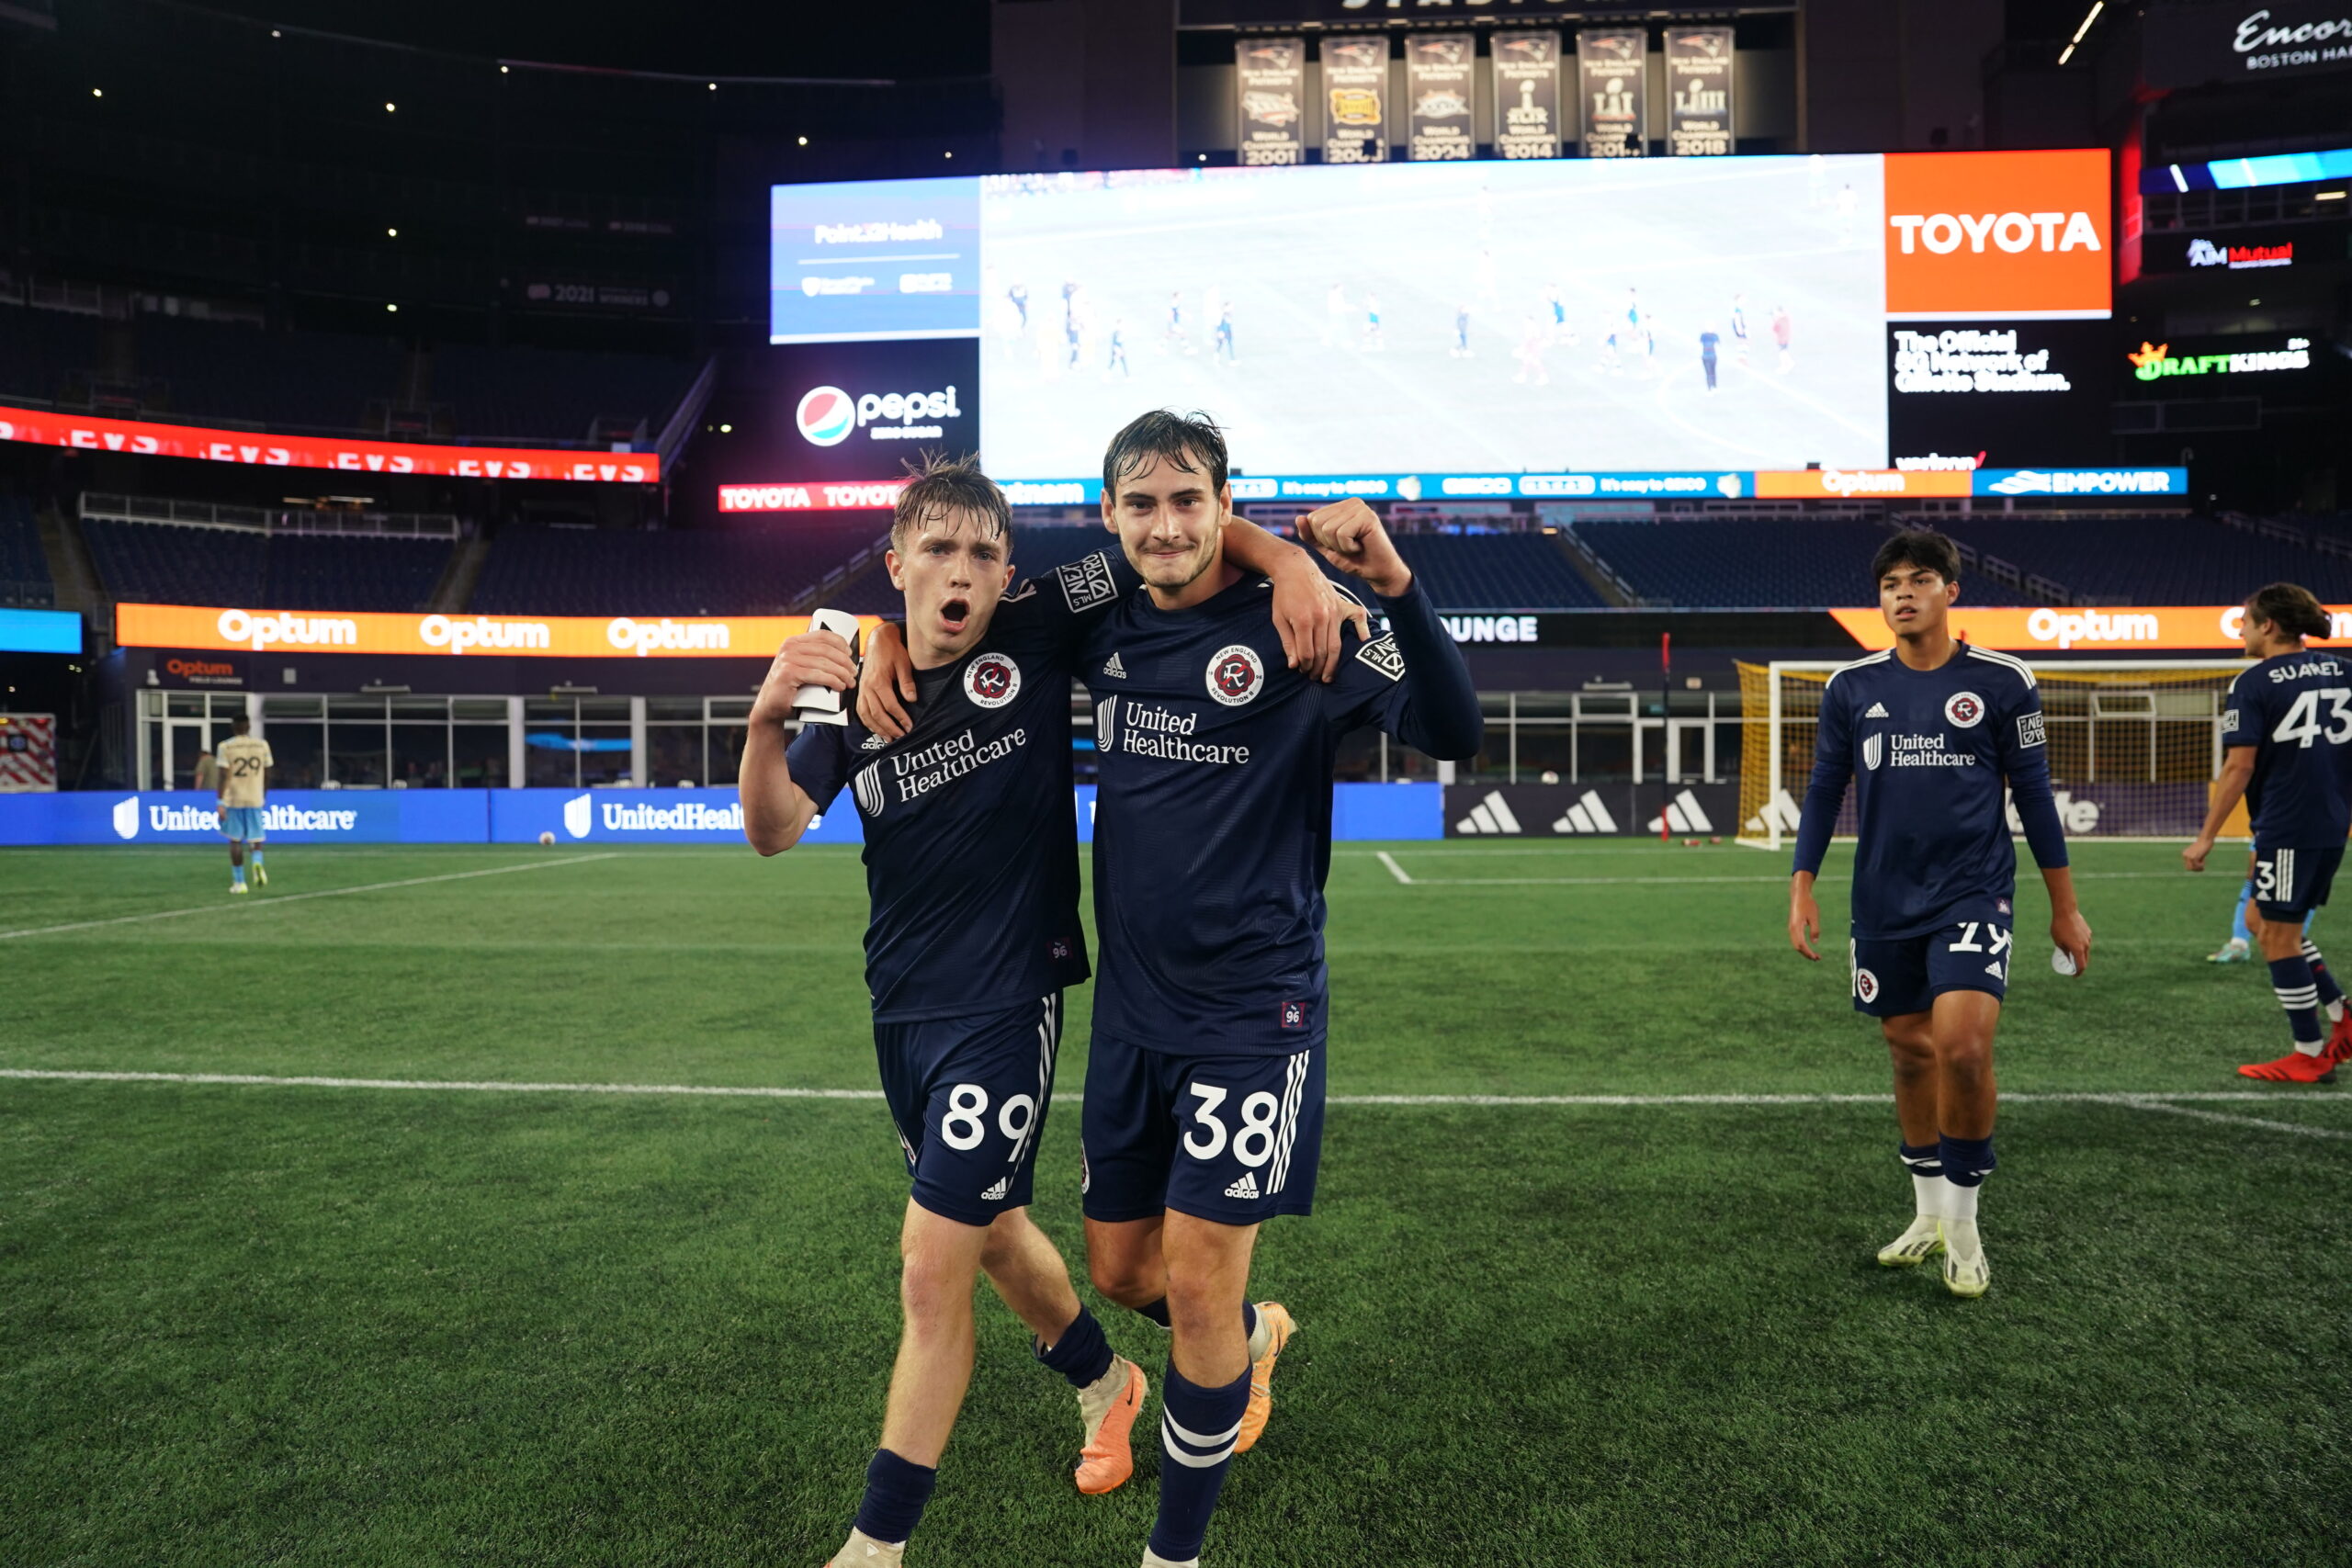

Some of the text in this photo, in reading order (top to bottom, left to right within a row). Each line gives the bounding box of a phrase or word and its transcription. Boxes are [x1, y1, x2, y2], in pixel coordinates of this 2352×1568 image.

[2246, 50, 2317, 70] BOSTON
[1246, 150, 1296, 165] 2001
[1503, 144, 1554, 159] 2014
[1676, 140, 1726, 155] 2018
[1891, 212, 2101, 254] TOYOTA
[2229, 242, 2293, 263] Mutual
[554, 284, 594, 303] 2021
[1894, 331, 1939, 352] The
[2023, 349, 2050, 371] of
[857, 386, 958, 427] pepsi
[1442, 477, 1512, 494] GEICO
[1821, 469, 1905, 496] Optum
[2052, 471, 2170, 494] EMPOWER
[721, 486, 899, 509] TOYOTA TOYOT
[1072, 593, 1092, 606] MLS
[218, 609, 356, 650] Optum
[420, 614, 549, 654] Optum
[606, 617, 729, 656] Optum
[2028, 608, 2158, 649] Optum
[1216, 647, 1258, 663] NEW ENGLAND
[1364, 649, 1384, 663] MLS
[166, 658, 233, 678] Optum
[967, 655, 1005, 679] NEW ENGLAND
[1103, 667, 1127, 680] adidas
[2268, 662, 2344, 683] SUAREZ
[979, 688, 1016, 706] REVOLUTION
[1211, 686, 1249, 704] REVOLUTION
[1126, 702, 1197, 735] United
[2272, 687, 2352, 749] 43
[1123, 728, 1250, 764] Healthcare
[1891, 733, 1945, 750] United
[891, 729, 975, 777] United
[1891, 750, 1975, 767] Healthcare
[232, 757, 261, 777] 29
[898, 728, 1026, 802] Healthcare
[1053, 945, 1068, 958] 96
[1286, 1010, 1300, 1023] 96
[941, 1083, 1035, 1163] 89
[1183, 1082, 1278, 1167] 38
[981, 1190, 1005, 1200] adida
[1225, 1188, 1260, 1200] adidas
